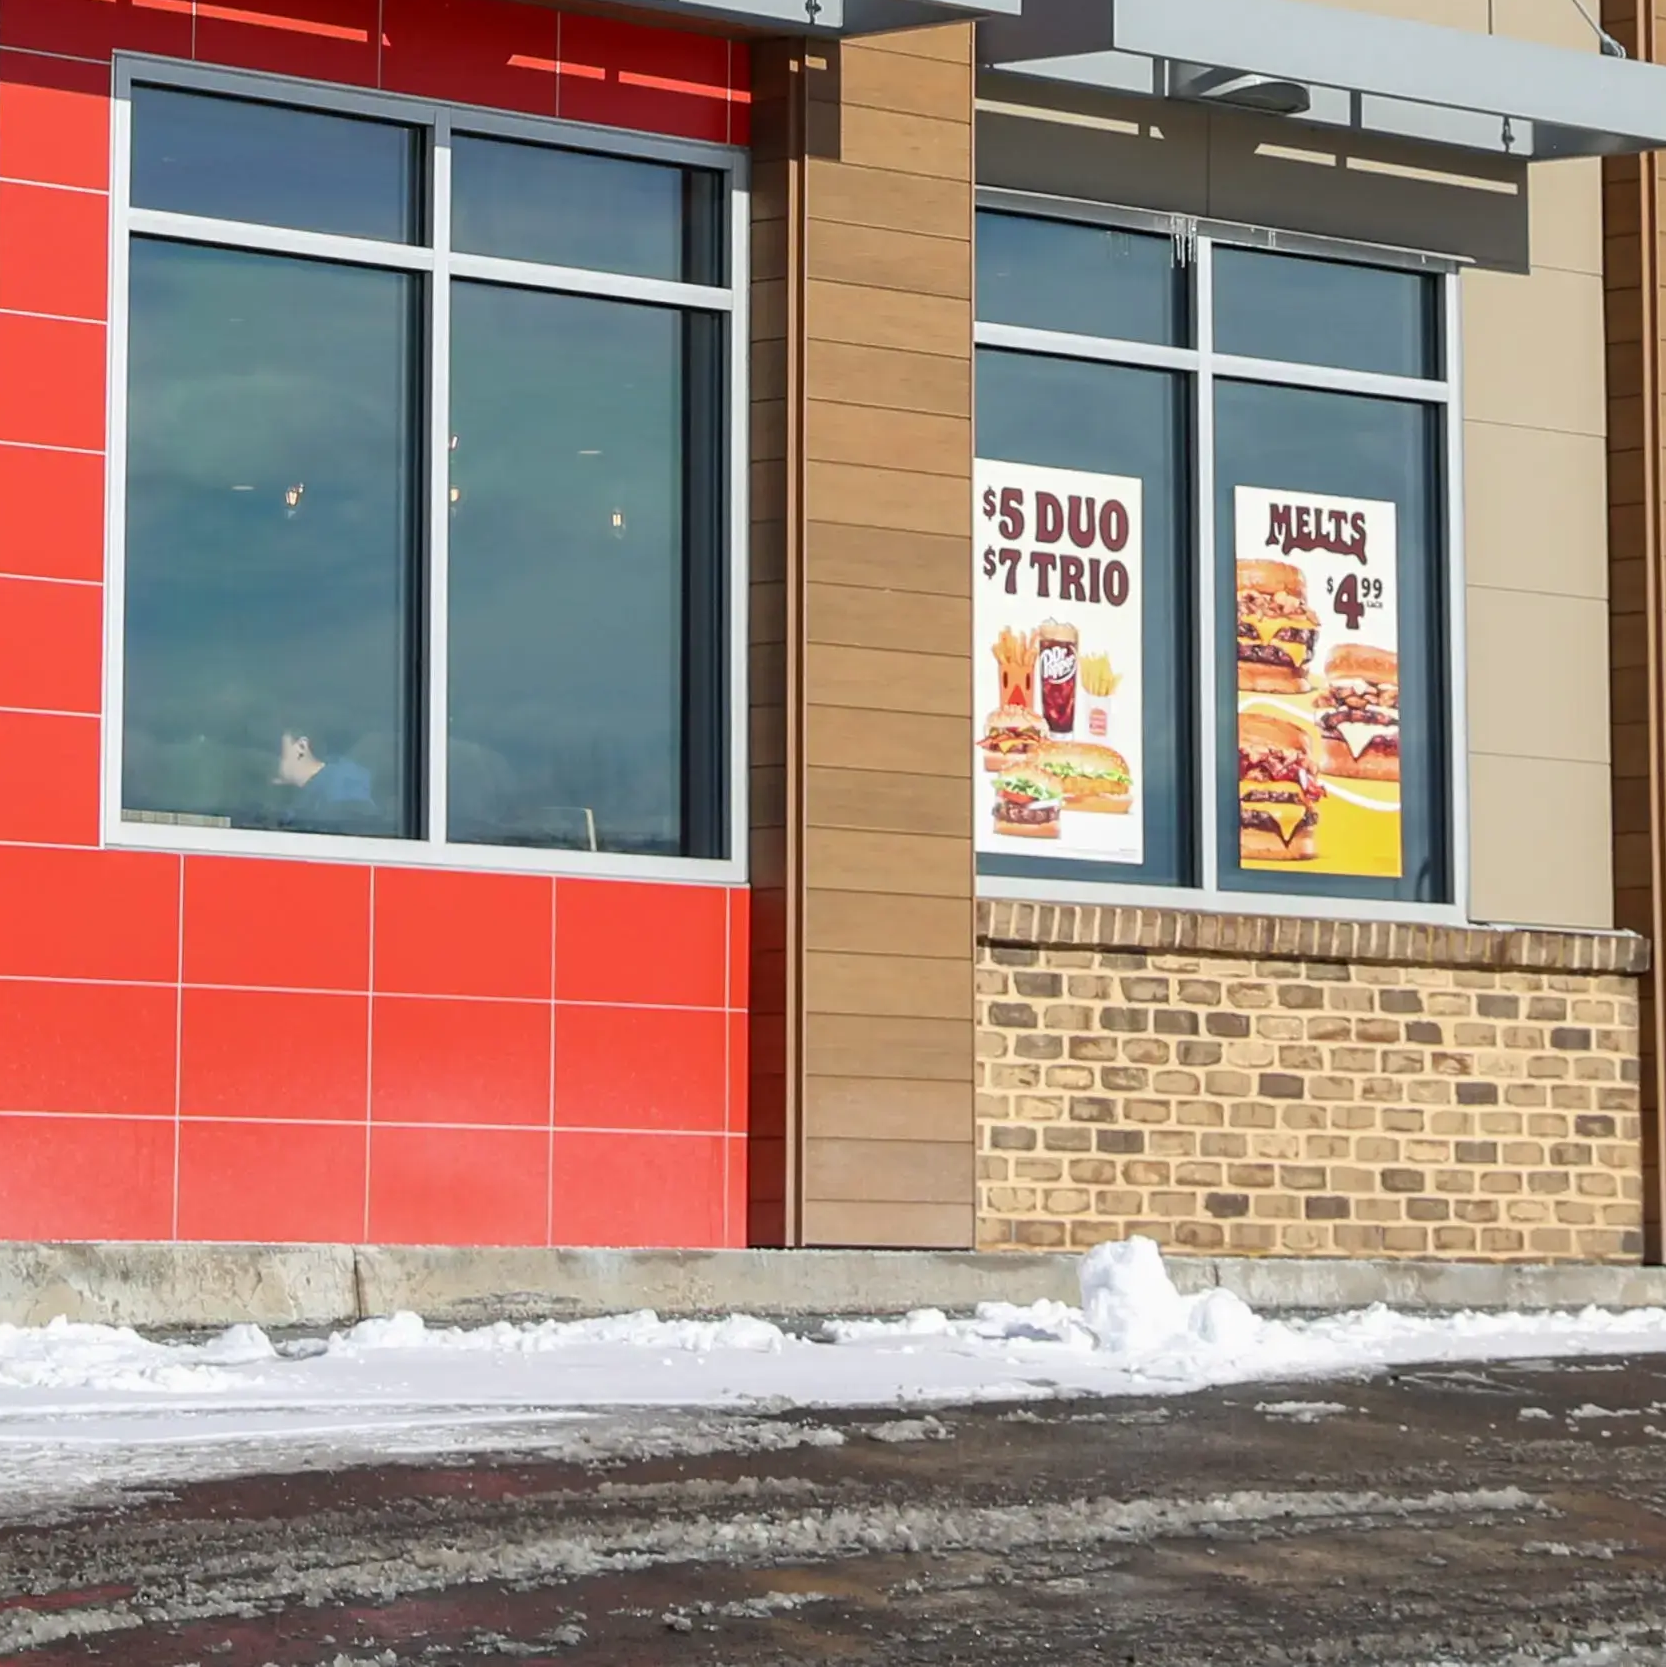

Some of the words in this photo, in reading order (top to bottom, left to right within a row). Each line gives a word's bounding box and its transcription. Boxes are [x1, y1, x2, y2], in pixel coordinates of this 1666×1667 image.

[983, 485, 1024, 541] $5
[1035, 490, 1130, 552] DUO
[1265, 502, 1368, 566] MELTS
[983, 544, 1022, 595] $7
[1030, 551, 1130, 607] TRIO
